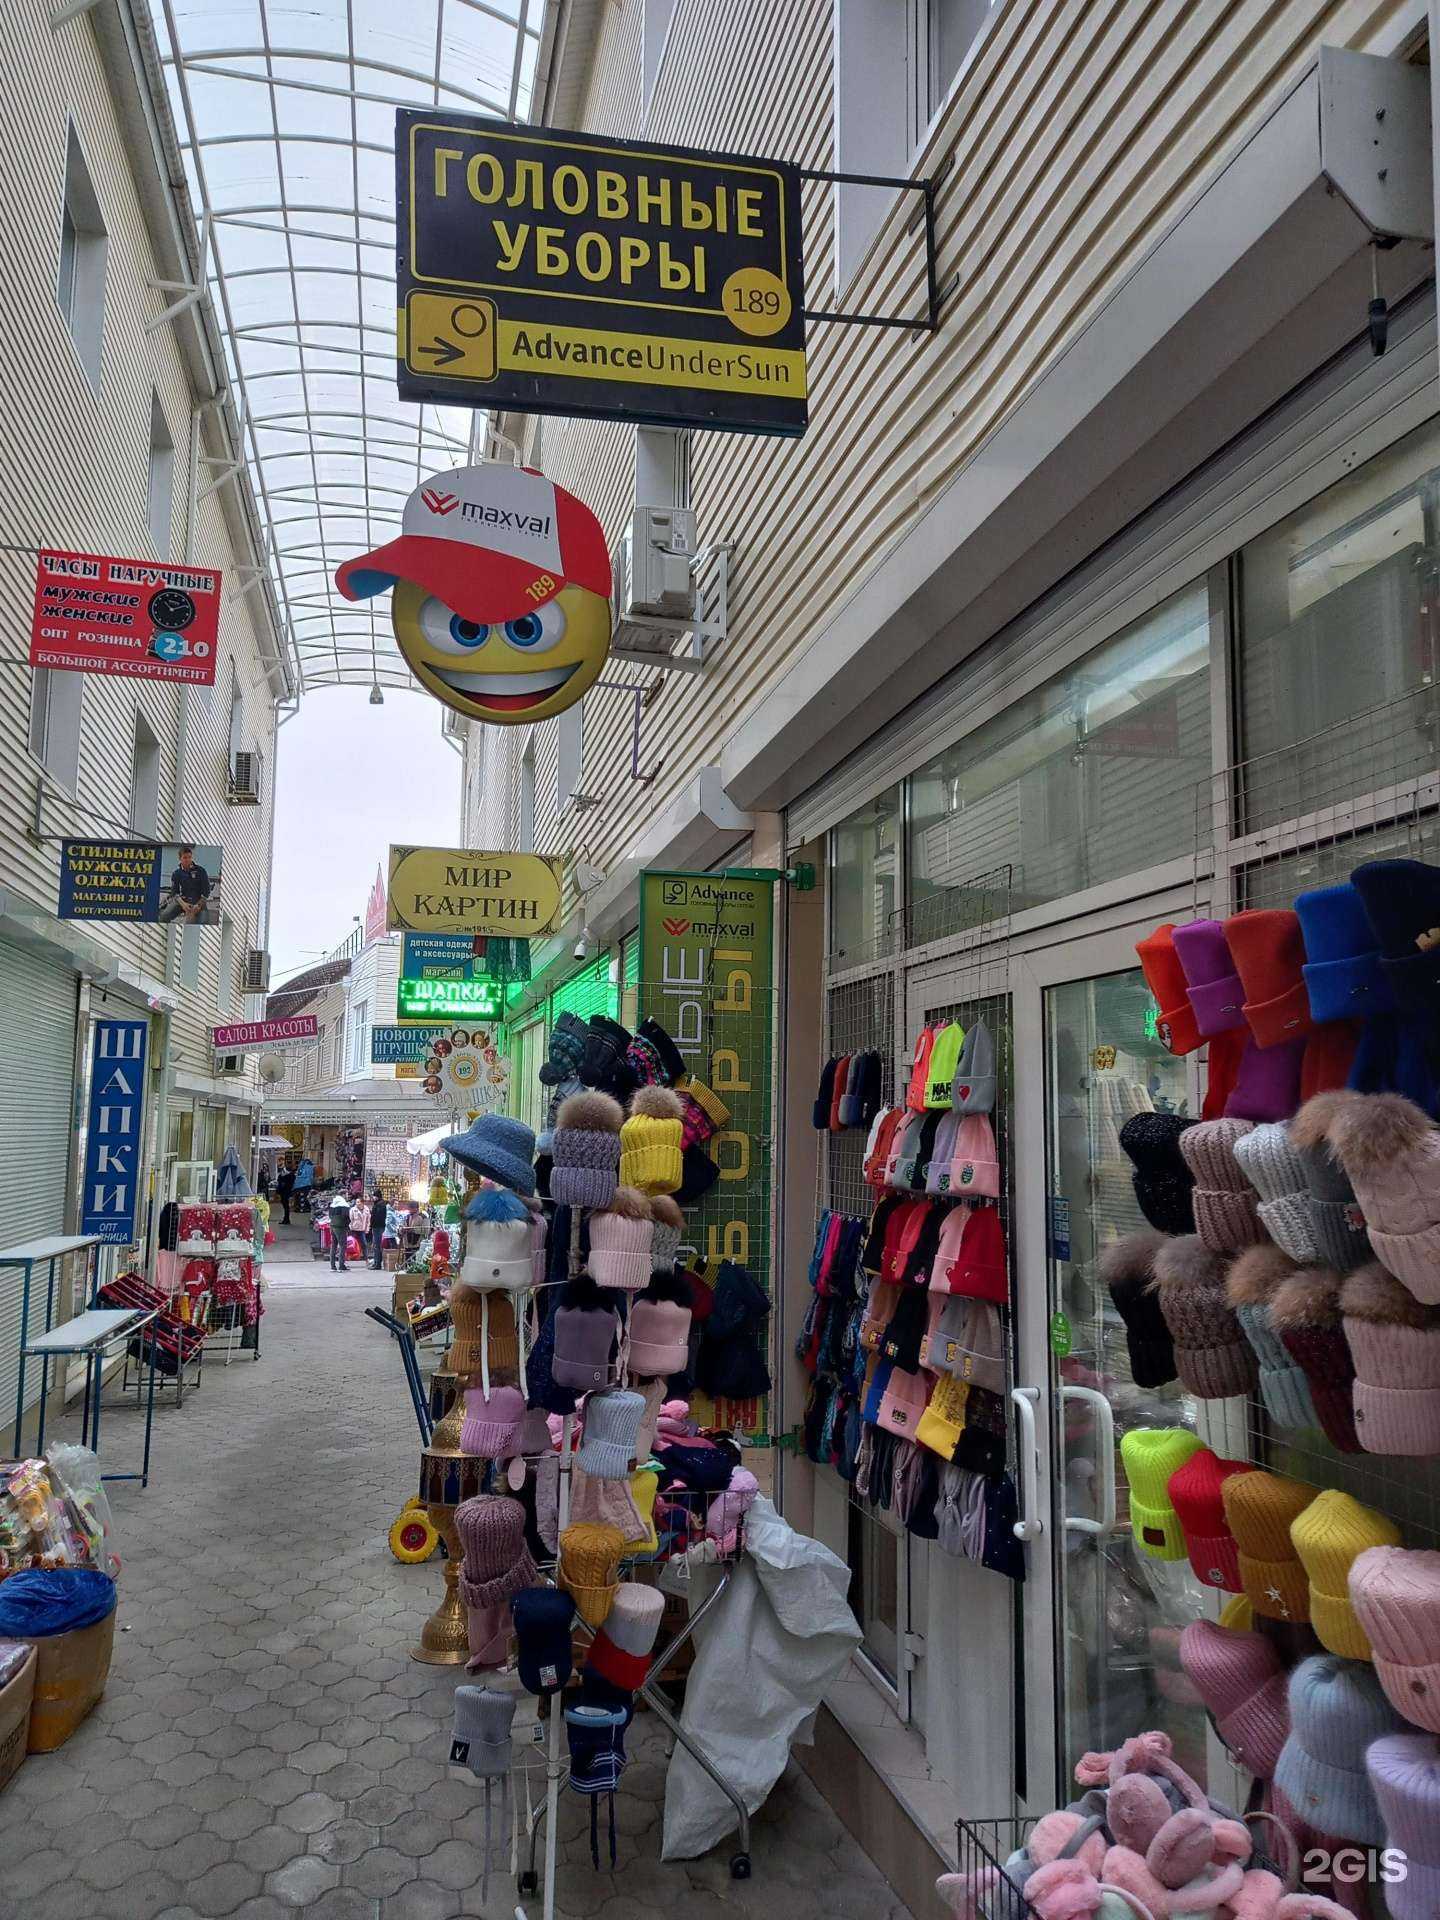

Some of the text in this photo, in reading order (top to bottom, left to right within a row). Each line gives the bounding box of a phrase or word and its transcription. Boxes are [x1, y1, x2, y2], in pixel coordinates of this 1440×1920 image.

[434, 148, 763, 238] ГОЛОВНЫЕ
[491, 220, 706, 293] УБОРЫ
[733, 287, 781, 316] 189
[512, 330, 790, 383] AdvanceUnderSun
[462, 502, 551, 534] maxval
[43, 556, 215, 591] ЧАСЫ НАРУЧНЫЕ
[43, 585, 140, 607] мужские
[524, 574, 556, 602] 189
[41, 604, 134, 625] женские
[41, 627, 142, 648] ОПТ РОЗНИЦА
[162, 637, 209, 657] 210
[37, 652, 208, 680] БОЛЬШОЙ АССОРТИМЕНТ
[68, 846, 155, 860] СТИЛЬНАЯ
[69, 860, 152, 874] МУЖСКАЯ
[444, 866, 512, 888] МИР
[75, 874, 146, 889] ОДЕЖДА
[72, 892, 145, 904] МАГАЗИН 211
[690, 884, 755, 901] Advance
[414, 894, 539, 920] КАРТИН
[691, 921, 755, 937] maxval
[410, 939, 473, 949] детская одежд
[415, 980, 487, 1001] ШАПКИ
[217, 1018, 315, 1043] САЛОН КРАСОТЫ
[374, 1042, 423, 1055] ИГРУШК
[92, 1028, 142, 1213] ШАПКИ
[99, 1222, 119, 1232] ОПТ
